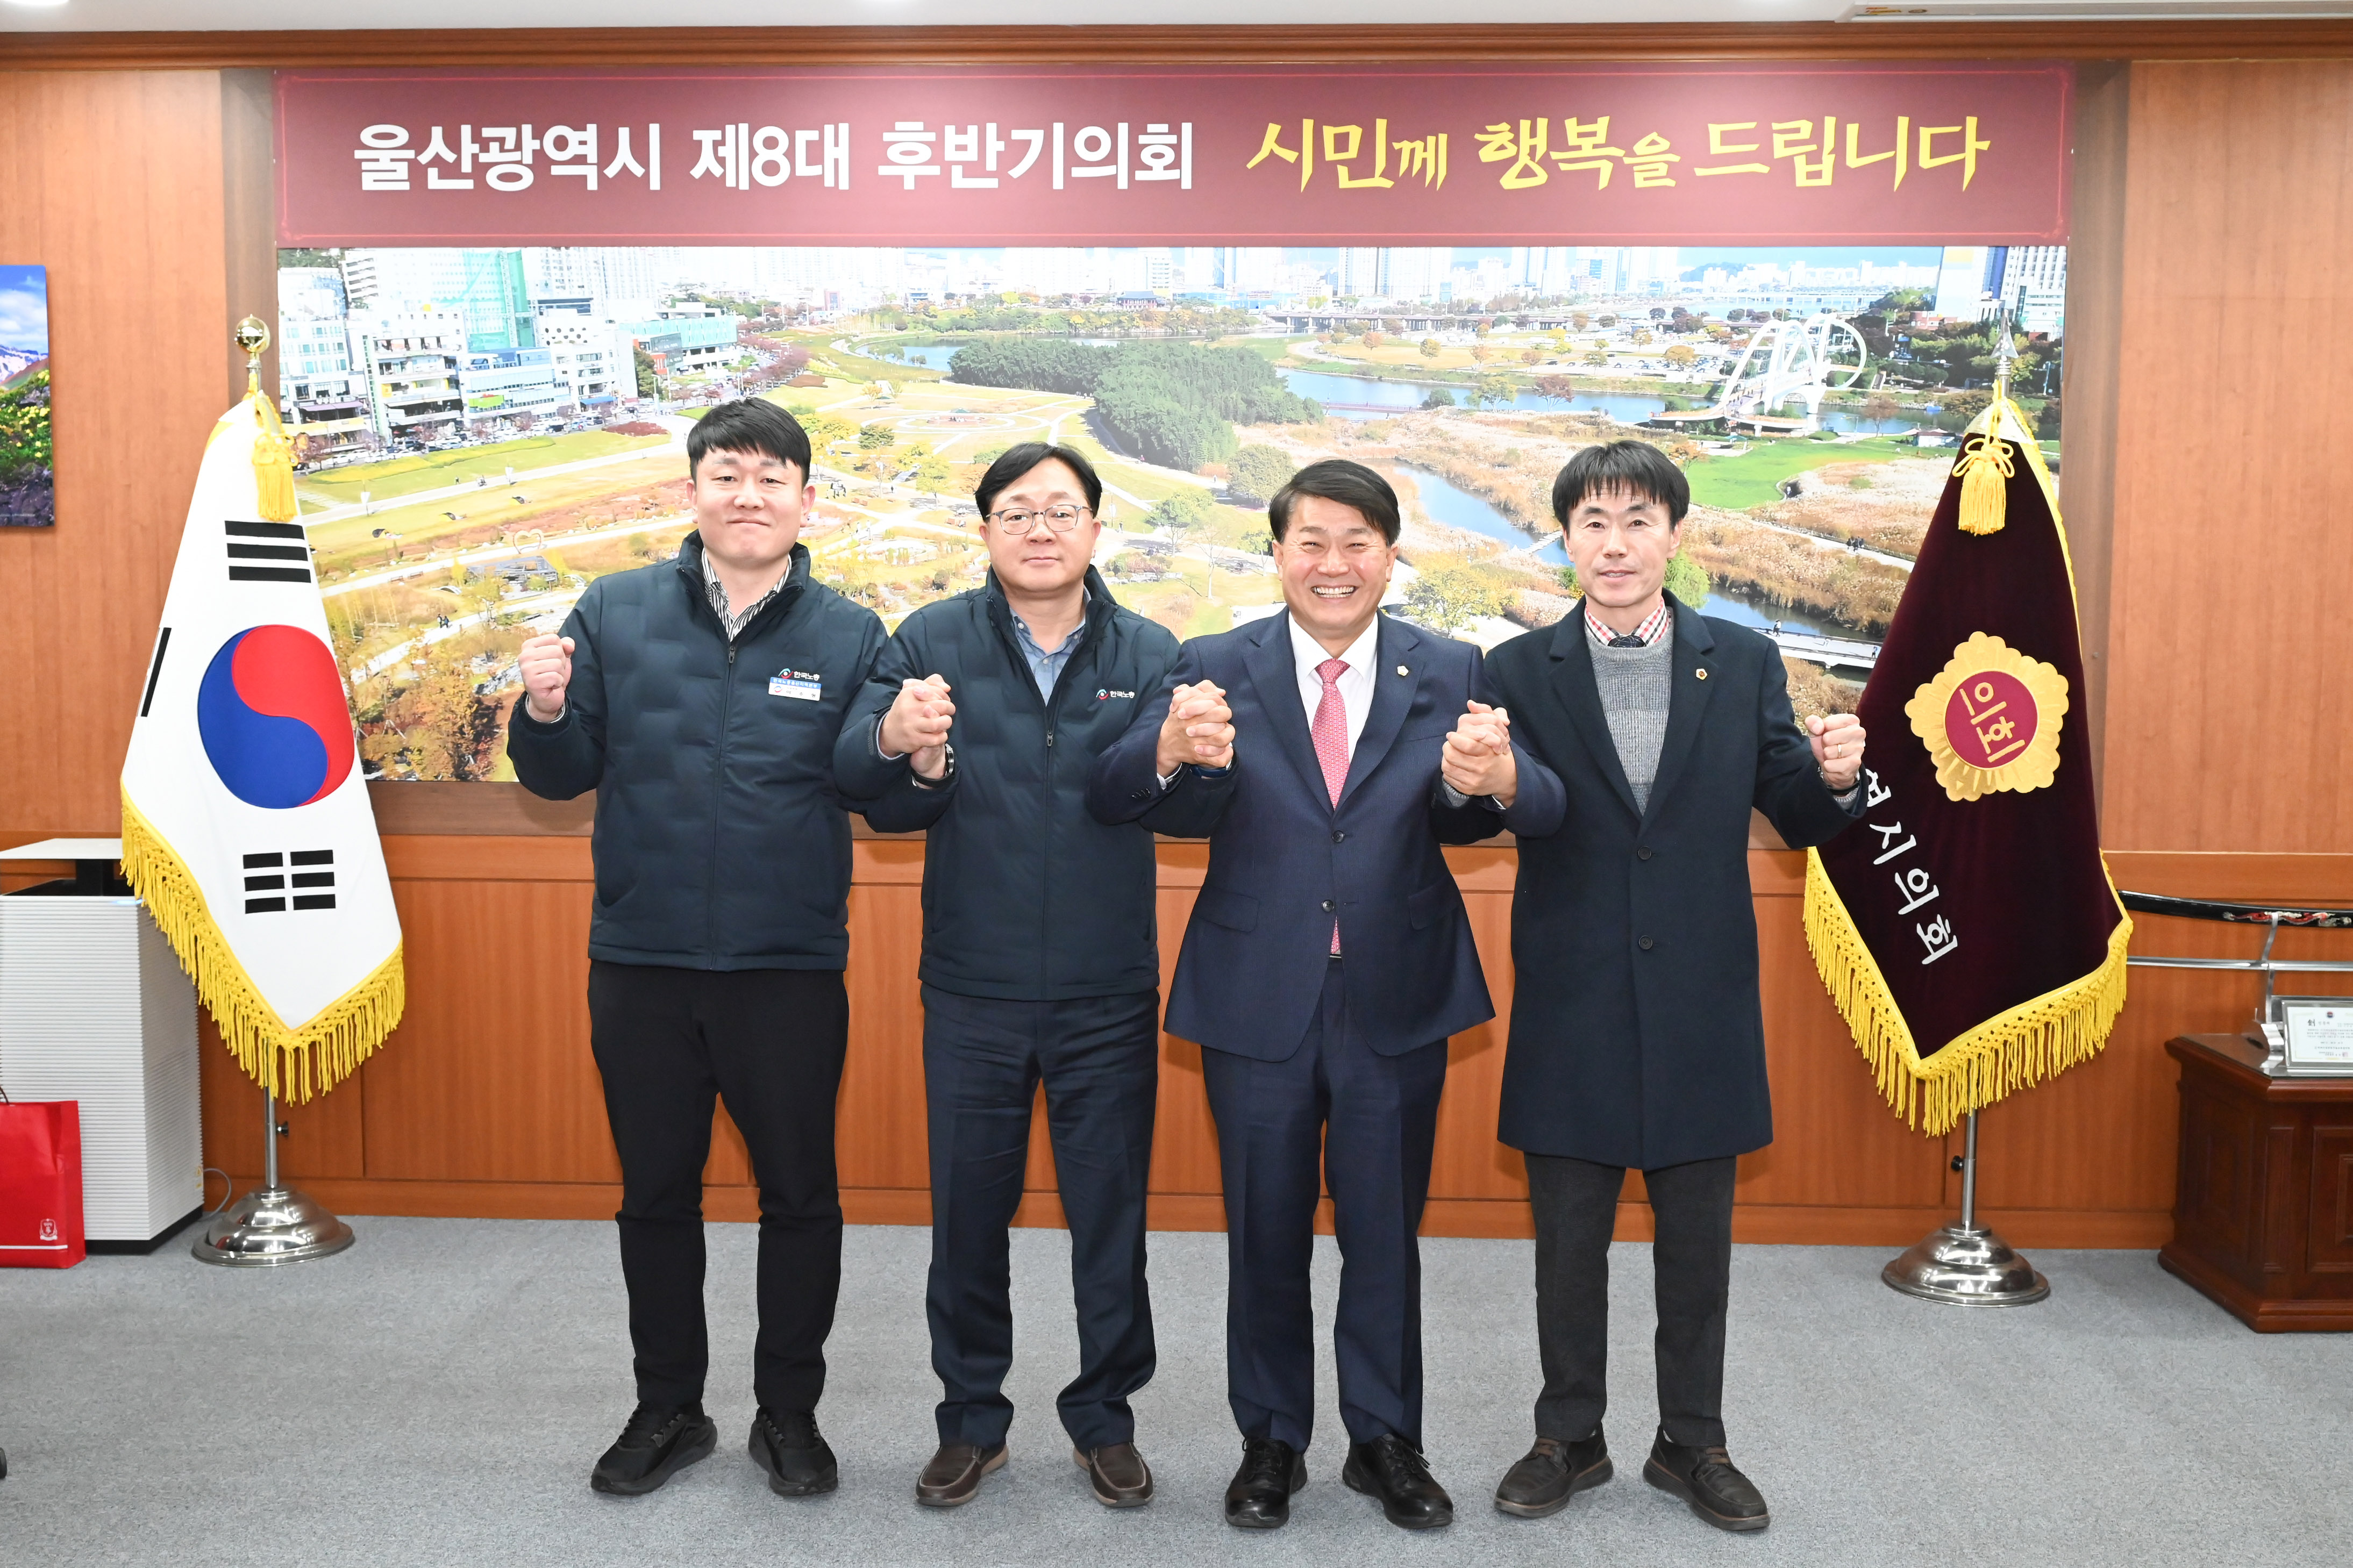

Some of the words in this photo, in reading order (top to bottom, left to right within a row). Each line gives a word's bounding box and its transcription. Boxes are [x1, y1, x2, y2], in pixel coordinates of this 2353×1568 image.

[354, 123, 661, 191] 울산광역시
[689, 123, 849, 190] 제8대
[878, 121, 1192, 190] 후반기의회
[1246, 118, 1448, 192] 시민께
[1474, 116, 1681, 190] 행복을
[1694, 116, 1991, 191] 드립니다
[794, 671, 820, 681] 한국노총
[1110, 690, 1135, 699] 한국노총
[1959, 682, 2026, 763] 의회
